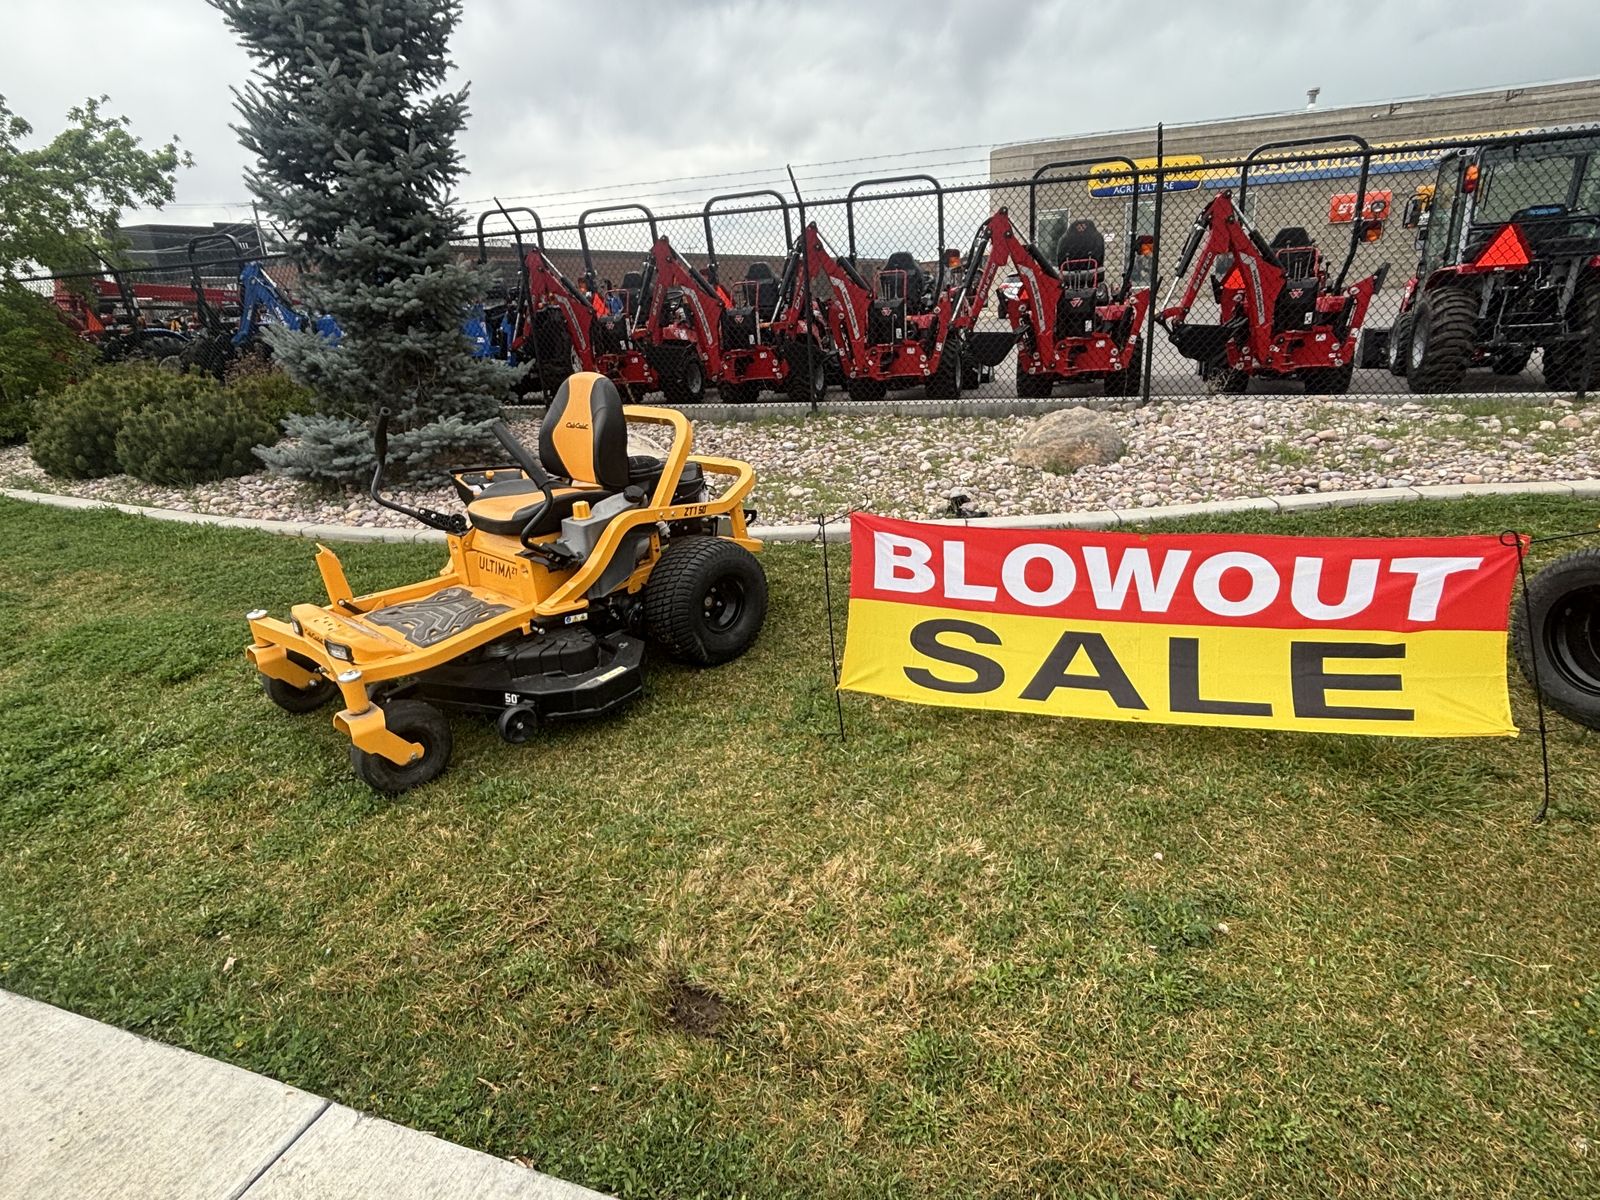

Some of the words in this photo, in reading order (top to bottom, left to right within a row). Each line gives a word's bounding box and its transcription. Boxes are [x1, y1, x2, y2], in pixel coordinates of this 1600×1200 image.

[683, 506, 697, 517] ZT1
[479, 555, 511, 580] ULTIMA
[873, 531, 1484, 622] BLOWOUT
[903, 618, 1415, 721] SALE
